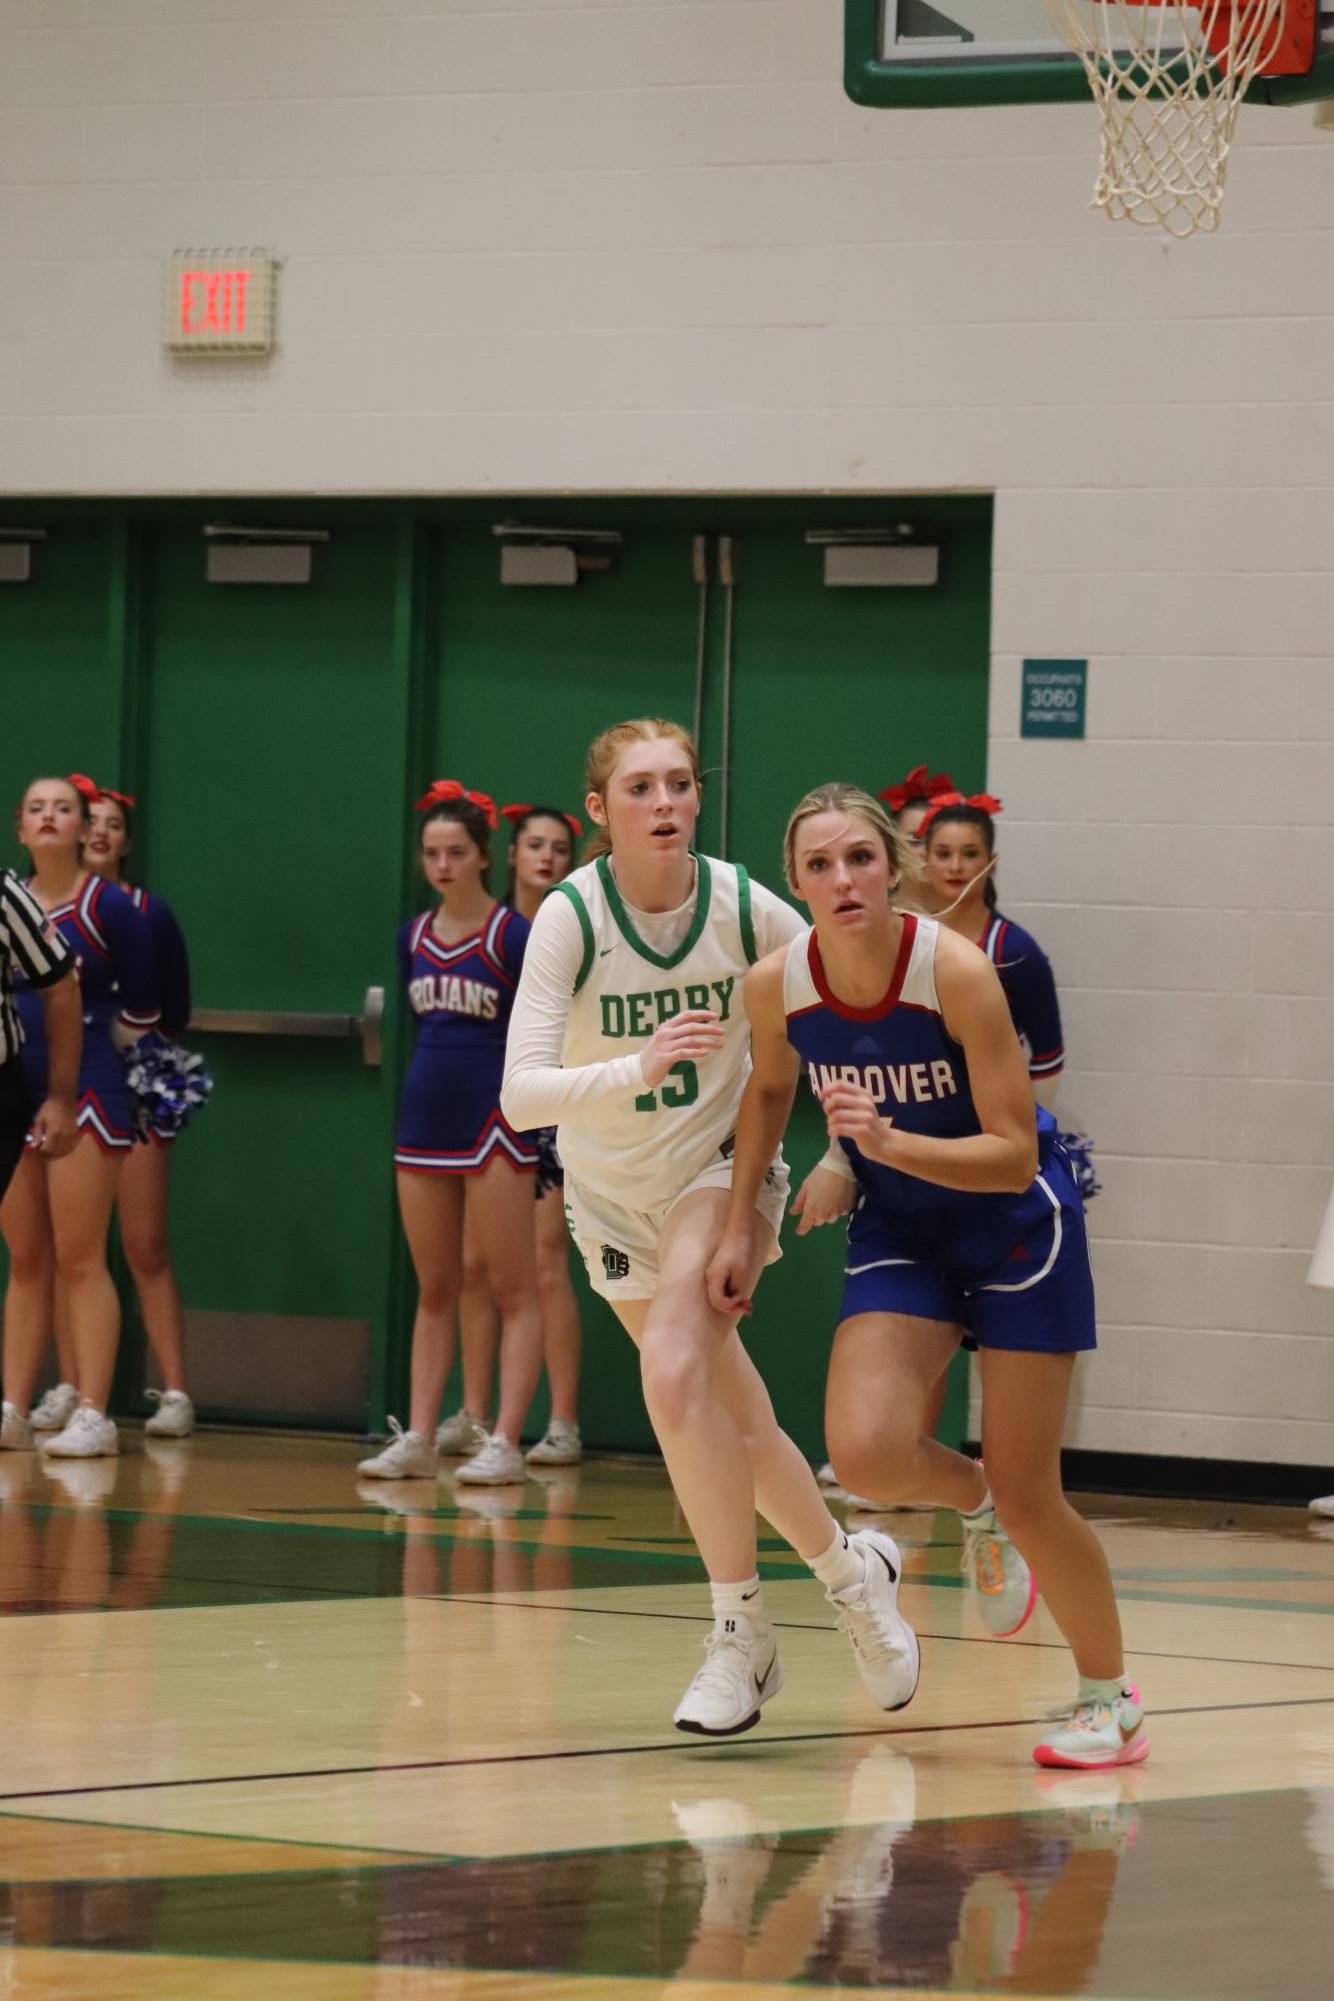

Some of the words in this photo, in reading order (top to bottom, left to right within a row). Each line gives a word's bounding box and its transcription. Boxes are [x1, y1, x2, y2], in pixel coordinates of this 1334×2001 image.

[181, 271, 252, 334] EXIT
[1030, 688, 1077, 708] 3060
[408, 975, 499, 1020] ROJANS
